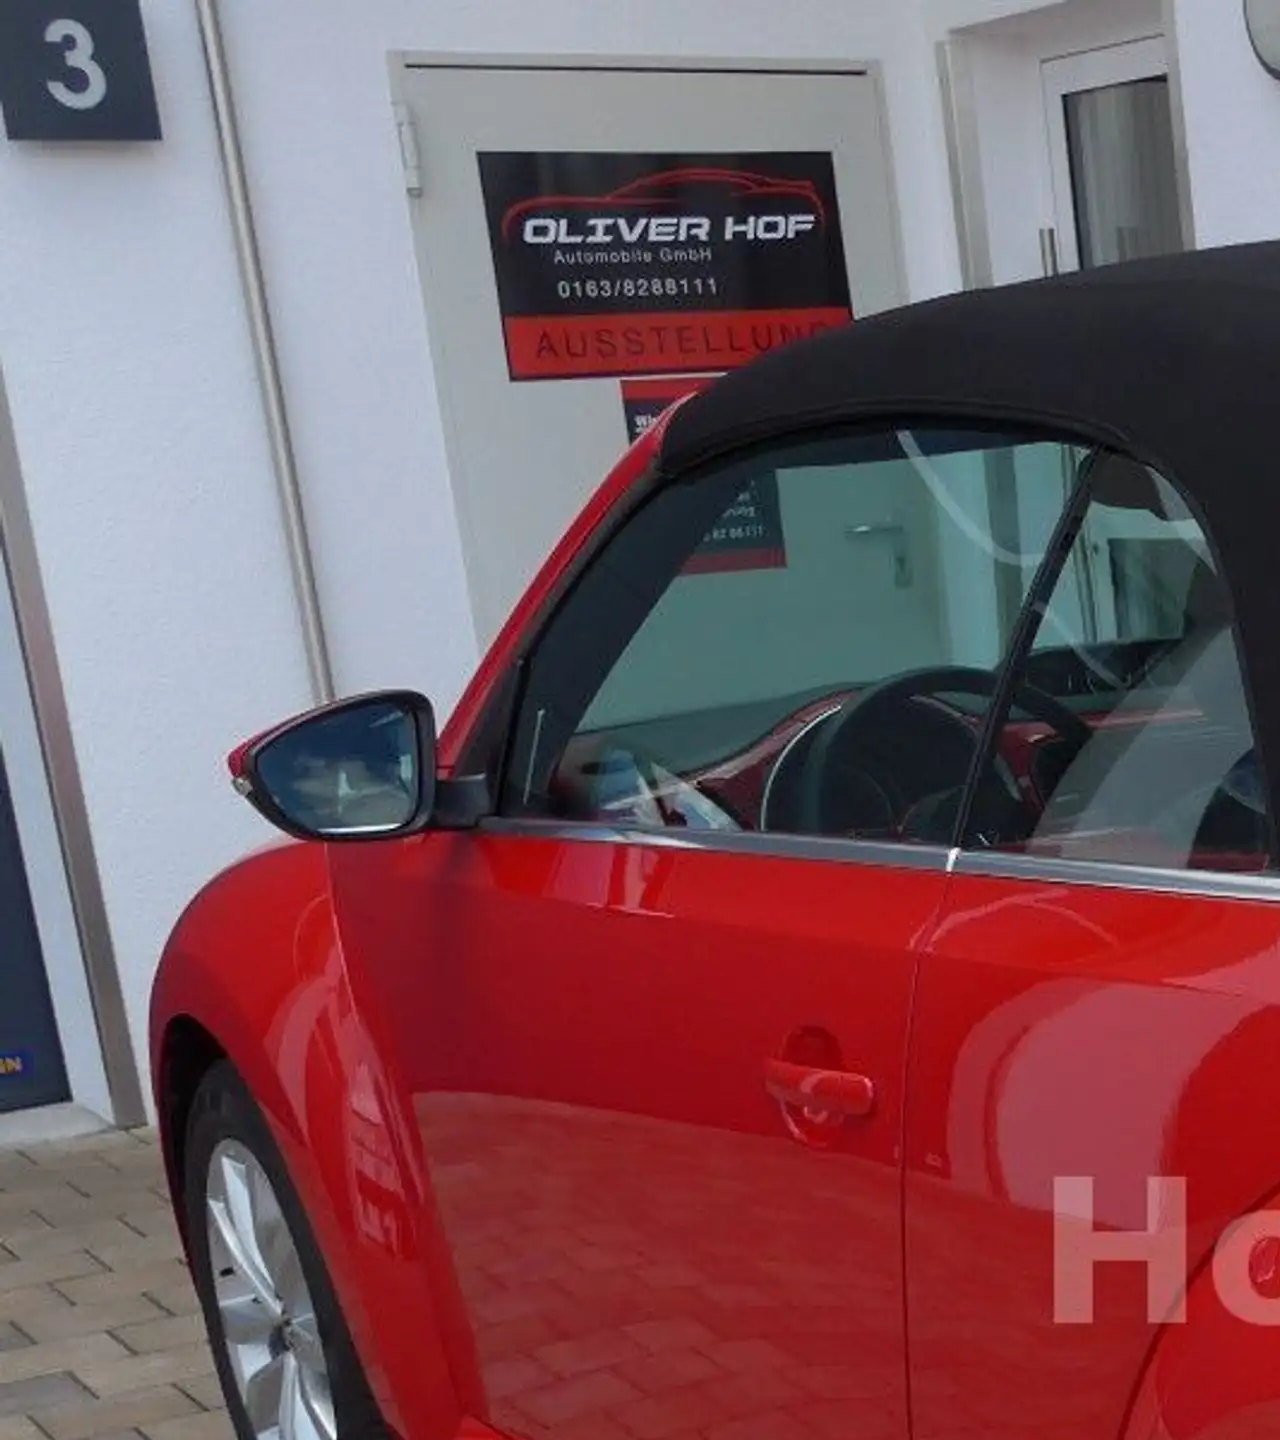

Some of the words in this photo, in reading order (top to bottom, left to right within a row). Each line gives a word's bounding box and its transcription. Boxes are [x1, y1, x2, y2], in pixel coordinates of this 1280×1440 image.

[45, 18, 107, 109] 3
[523, 217, 711, 244] OLIVER
[724, 215, 815, 240] HOF
[554, 250, 653, 264] Automobile
[659, 248, 712, 262] GmbH
[557, 278, 718, 299] 0163/8288111
